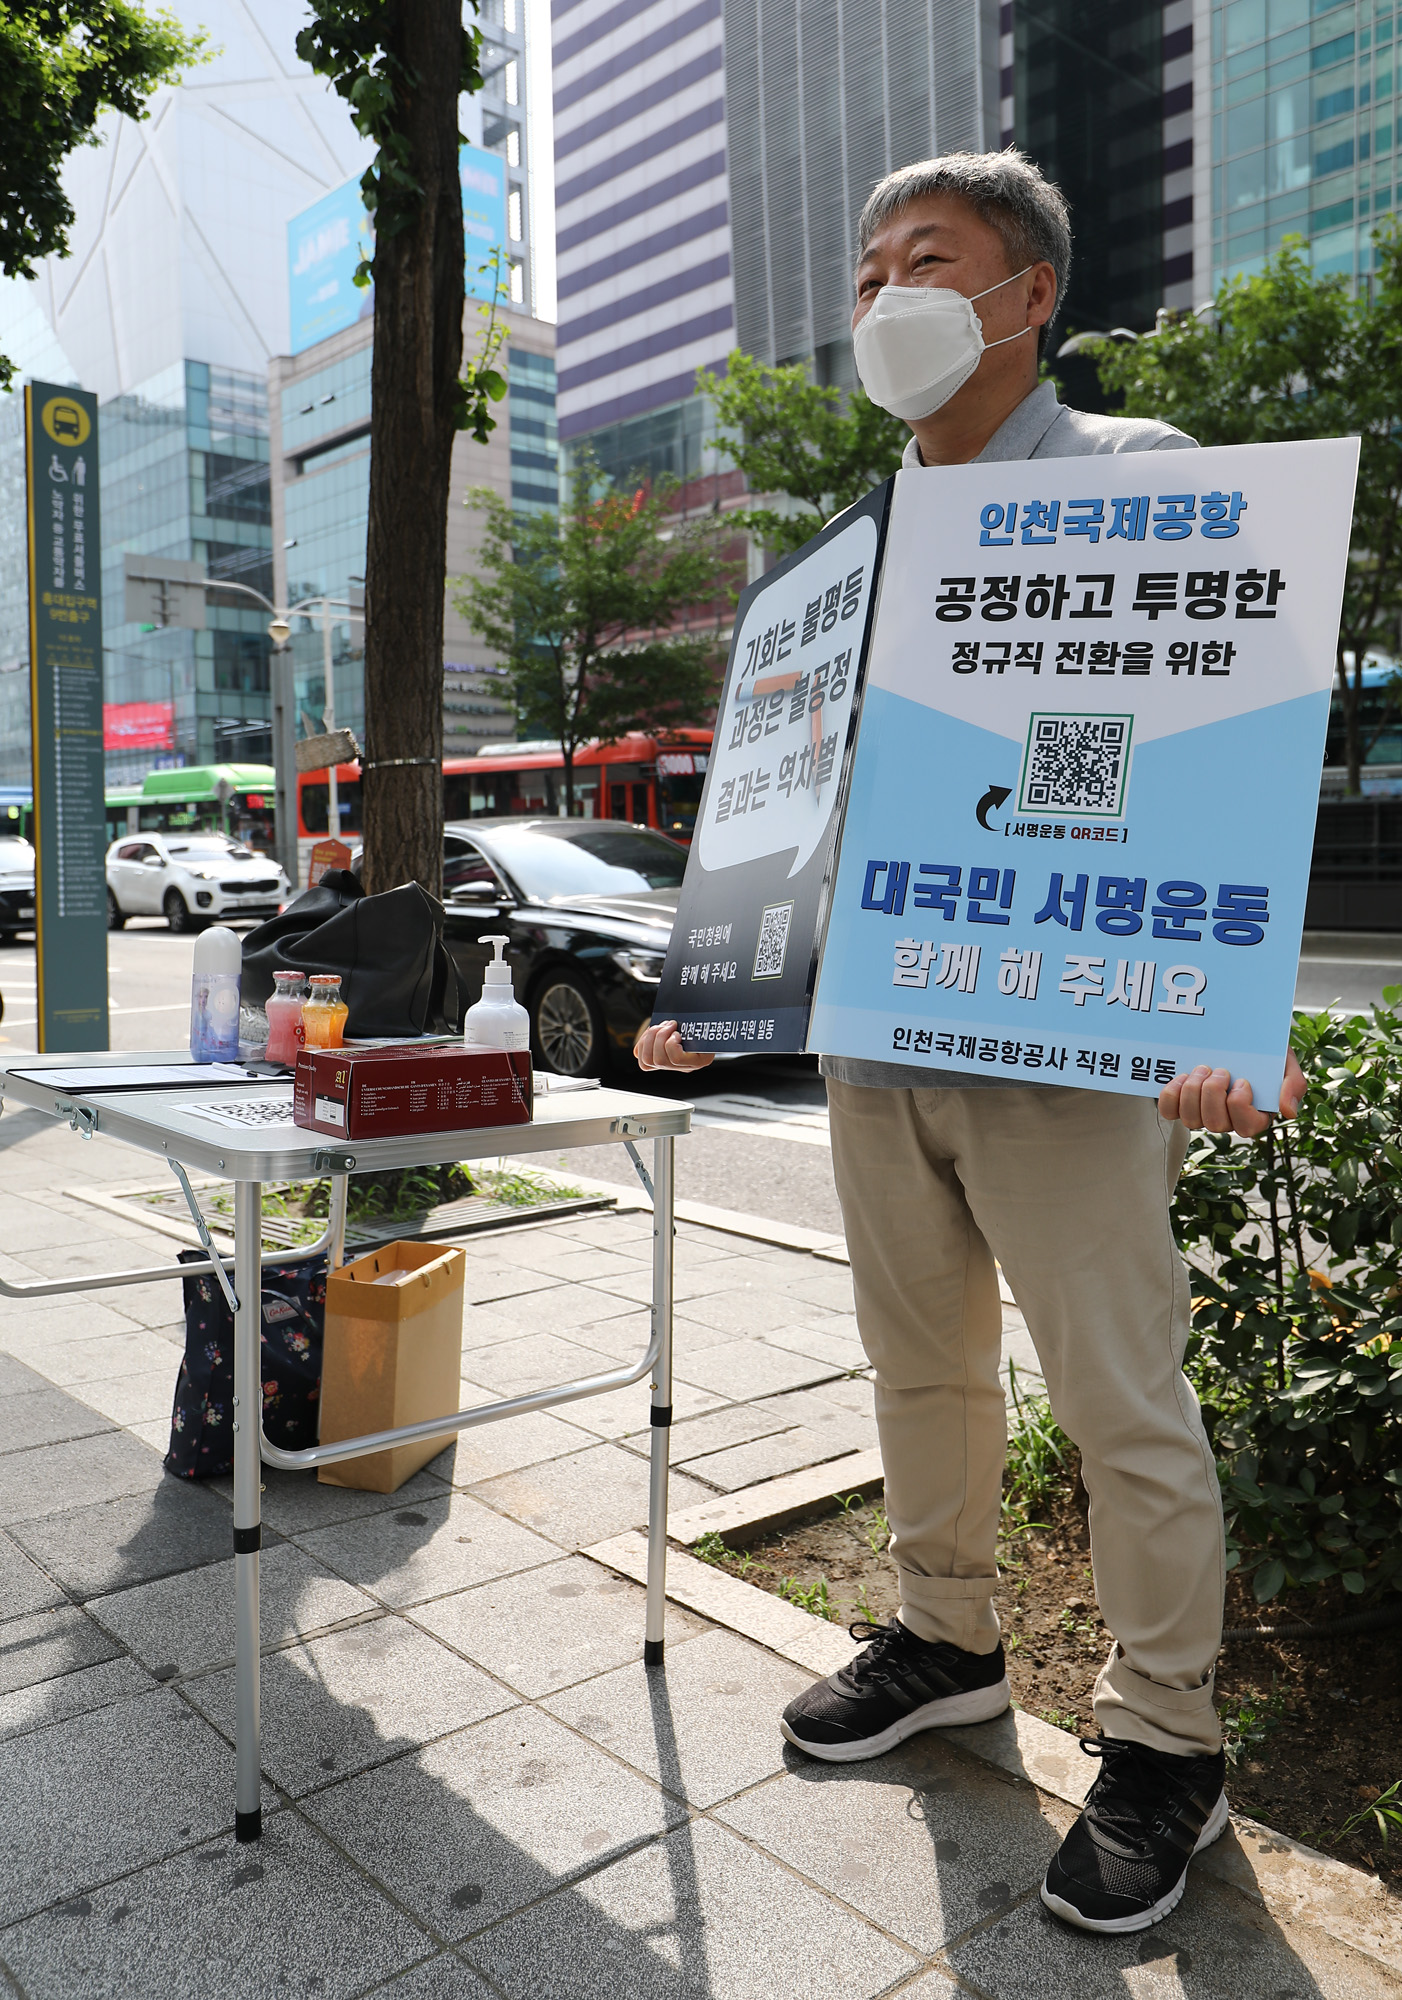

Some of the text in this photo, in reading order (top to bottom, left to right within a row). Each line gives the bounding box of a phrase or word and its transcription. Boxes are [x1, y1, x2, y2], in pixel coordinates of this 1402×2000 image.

[978, 491, 1248, 547] 인천국제공항
[741, 565, 865, 682] 기회는 불평등
[935, 568, 1286, 622] 공정하고 투명한
[951, 640, 1237, 676] 정규직 전환을 위한
[728, 648, 852, 751] 과정은 불공정
[715, 731, 839, 825] 결과는 역차별
[860, 860, 1271, 947] 대국민 서명운동
[688, 923, 733, 949] 국민청원에
[680, 960, 738, 986] 함께 해 주세요
[892, 937, 1208, 1017] 함께 해 주세요
[680, 1019, 775, 1041] 인천국제공항공사 직원 일동
[892, 1027, 1176, 1086] 인천국제공항공사 직원 일동
